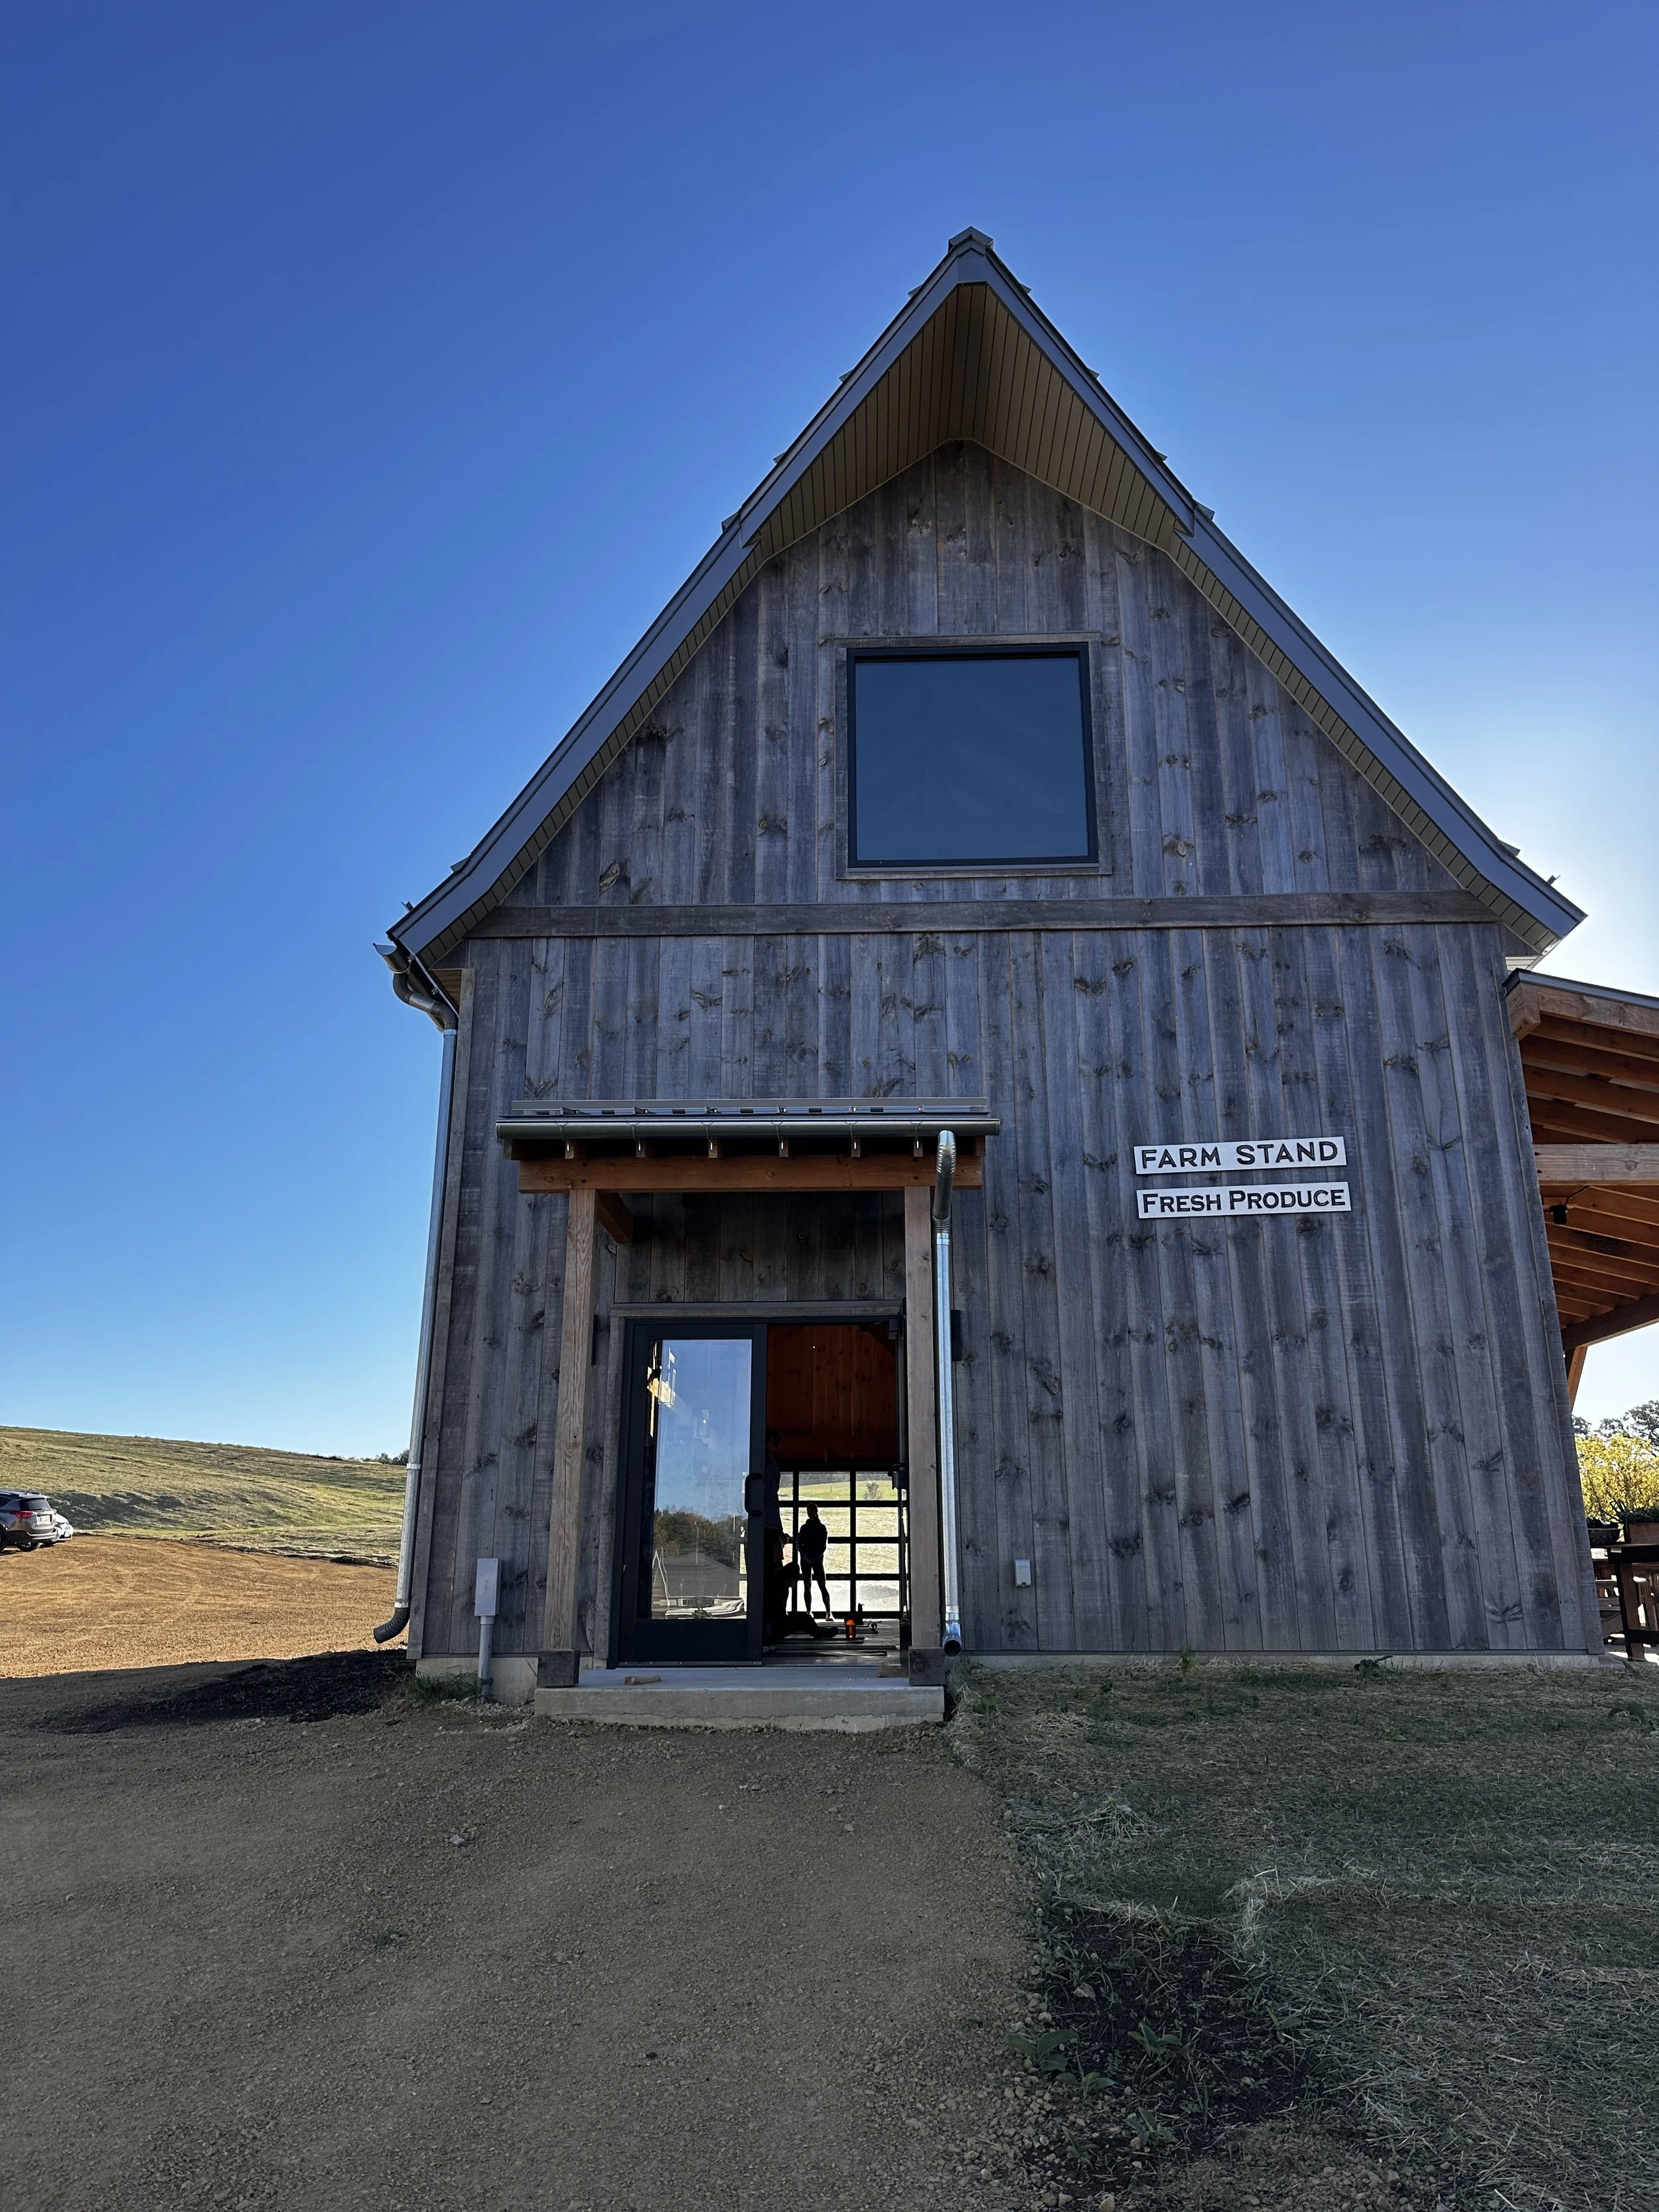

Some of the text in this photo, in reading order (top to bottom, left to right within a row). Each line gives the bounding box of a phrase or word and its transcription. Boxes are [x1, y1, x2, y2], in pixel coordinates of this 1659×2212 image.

[1141, 1141, 1338, 1169] FARM STAND
[1143, 1189, 1346, 1213] FRESH PRODUCE
